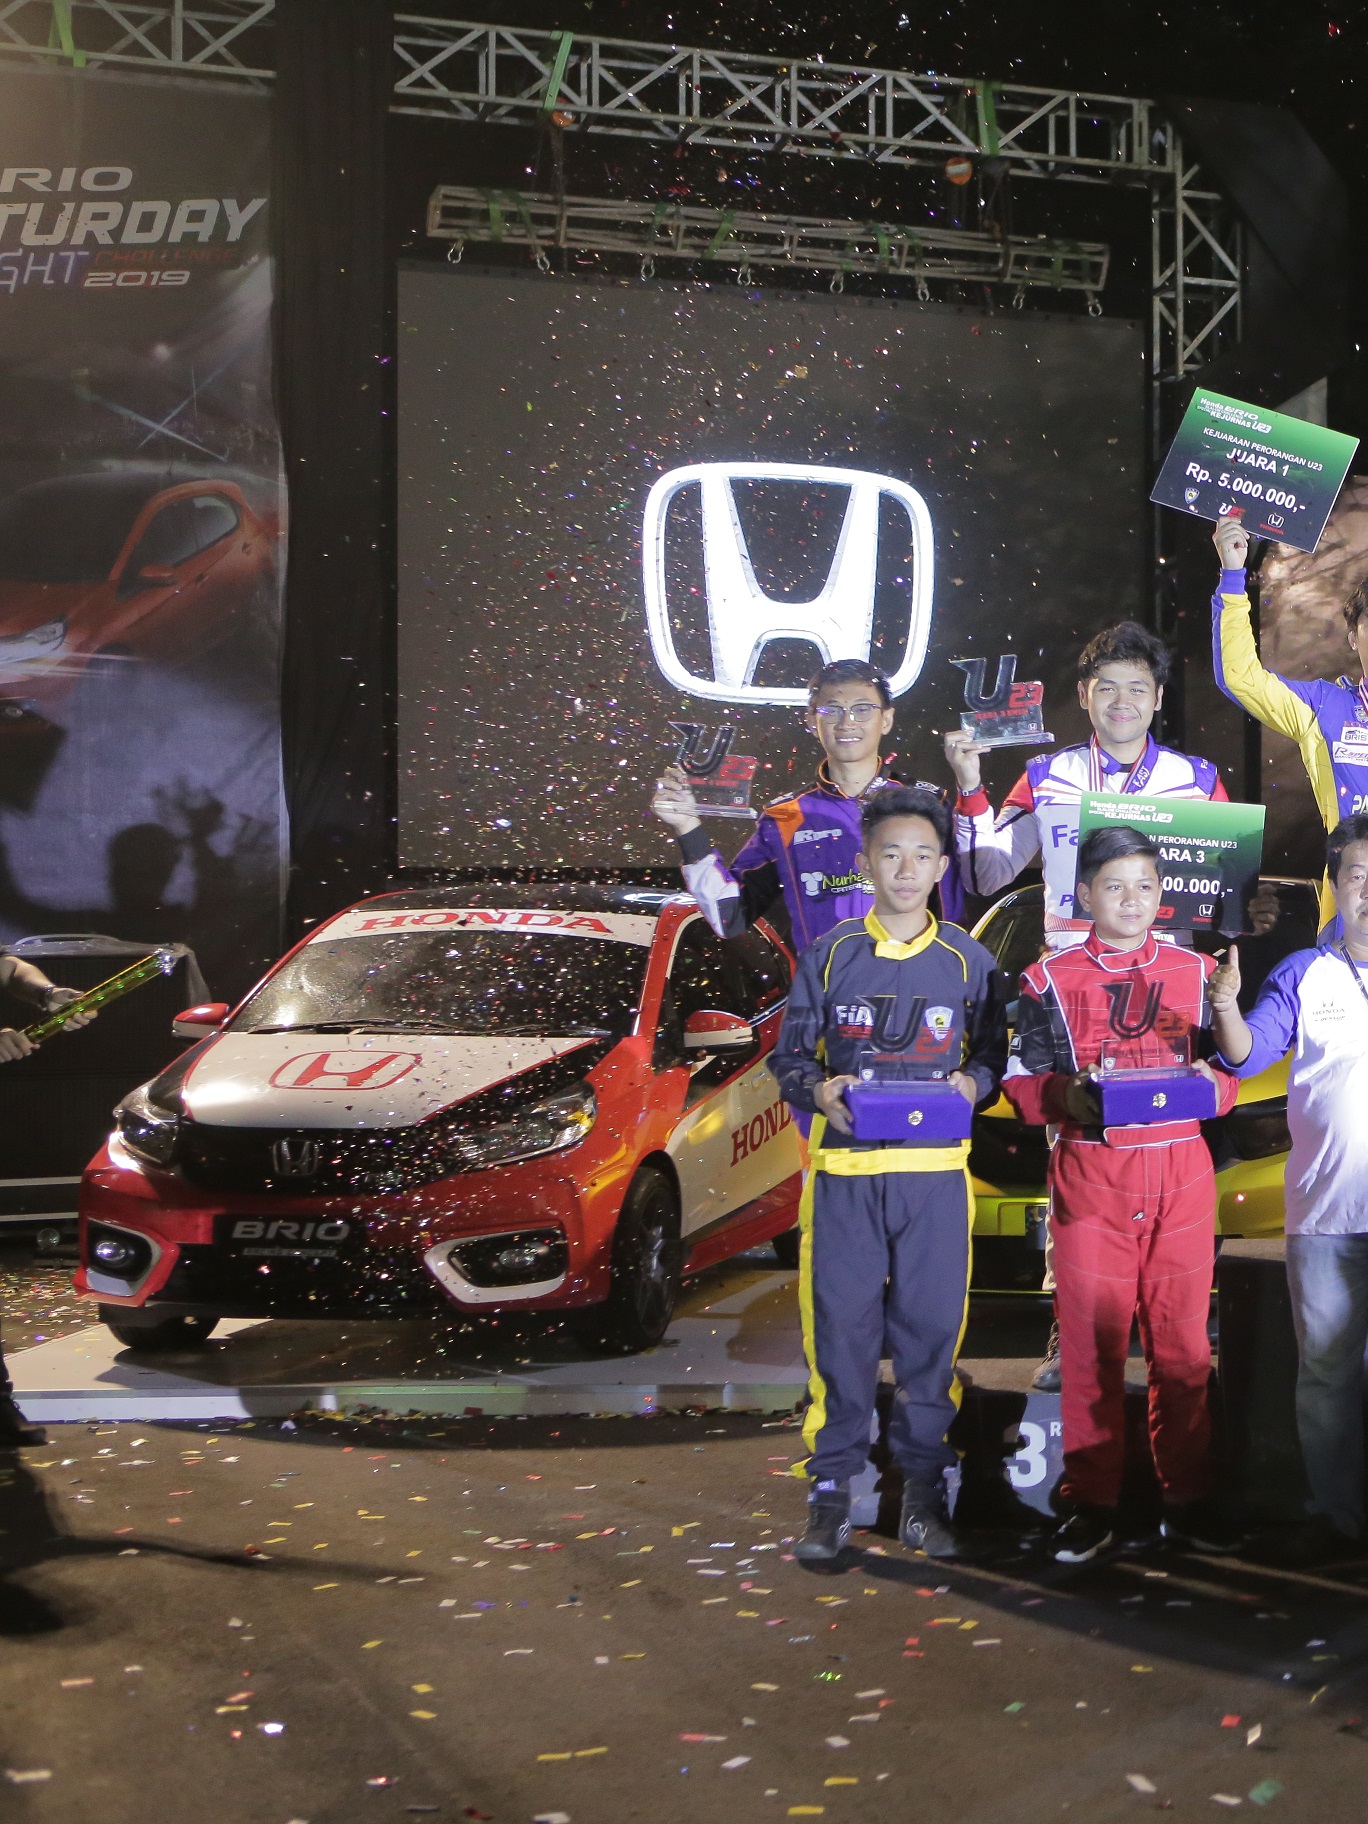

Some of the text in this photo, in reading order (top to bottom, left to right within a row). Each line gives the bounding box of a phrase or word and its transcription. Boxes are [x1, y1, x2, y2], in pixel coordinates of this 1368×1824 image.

[0, 166, 133, 193] RIO
[0, 198, 267, 245] TURDAY
[0, 249, 90, 293] GHT
[84, 270, 191, 287] 2019
[1200, 397, 1259, 421] Honda BRIO
[1210, 411, 1252, 428] KEJURNAS
[1252, 421, 1273, 434] U23
[1203, 427, 1323, 472] KEJUARAAN PERORANGAN U23
[1226, 447, 1290, 477] JUARA 1
[1186, 462, 1306, 513] Rp. 5.000.000,-
[1090, 800, 1156, 812] Honda BRIO
[1104, 811, 1151, 822] KEJURNAS
[1152, 812, 1174, 824] U23
[1051, 824, 1079, 848] Fa
[1158, 835, 1219, 848] PERORANGAN
[1221, 841, 1238, 849] U23
[1159, 847, 1205, 864] ARA 3
[1162, 876, 1233, 899] 00.000,-
[353, 911, 615, 934] HONDA
[730, 1100, 792, 1167] HOND
[231, 1221, 351, 1241] BRIO
[1003, 1421, 1062, 1488] 3 R
